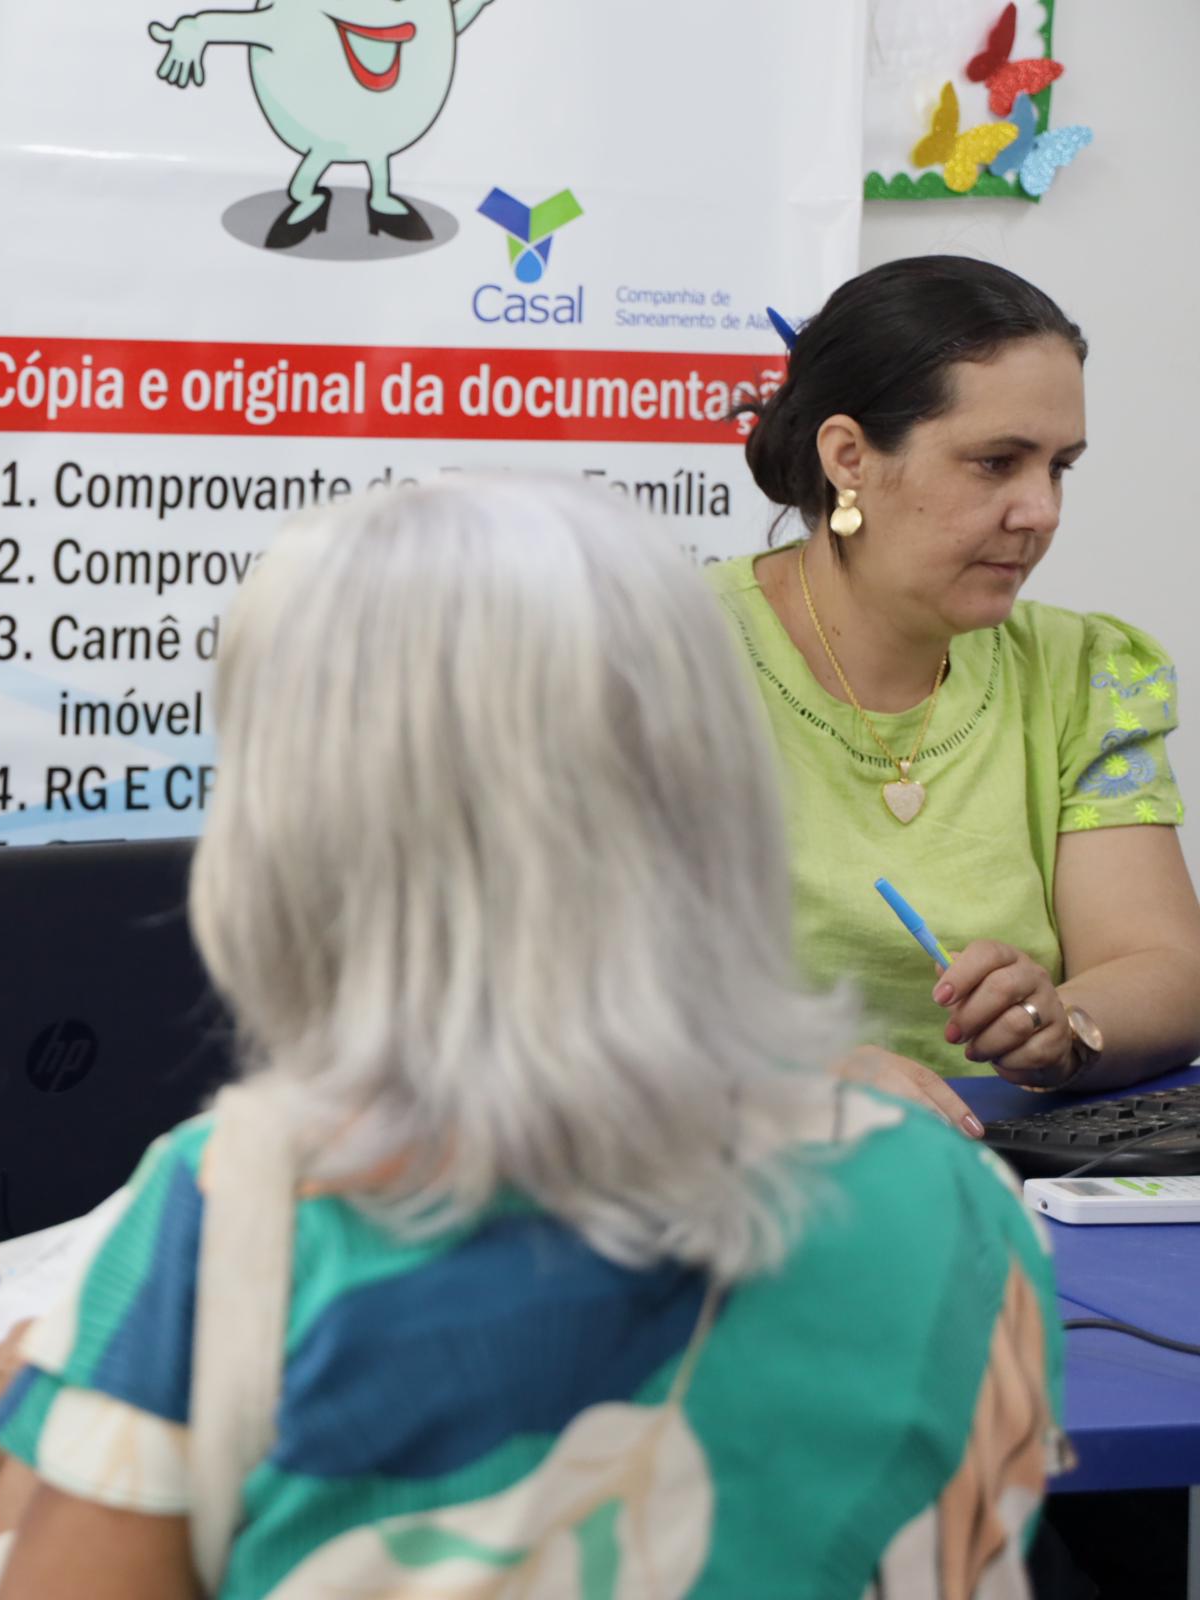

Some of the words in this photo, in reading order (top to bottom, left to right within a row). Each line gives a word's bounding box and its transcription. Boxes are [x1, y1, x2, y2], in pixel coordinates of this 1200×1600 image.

[473, 284, 583, 324] Casal
[615, 309, 716, 329] Saneamento
[721, 314, 742, 330] de
[616, 286, 705, 306] Companhia
[711, 290, 731, 306] de
[139, 368, 168, 411] e
[182, 358, 366, 425] original
[381, 362, 444, 416] da
[2, 461, 36, 507] 1.
[55, 461, 352, 520] Comprovante
[53, 538, 268, 596] Comprov
[50, 614, 180, 661] Carnê
[59, 687, 202, 736] imóvel
[46, 765, 107, 811] RG
[125, 767, 149, 811] E
[34, 1019, 91, 1091] hp
